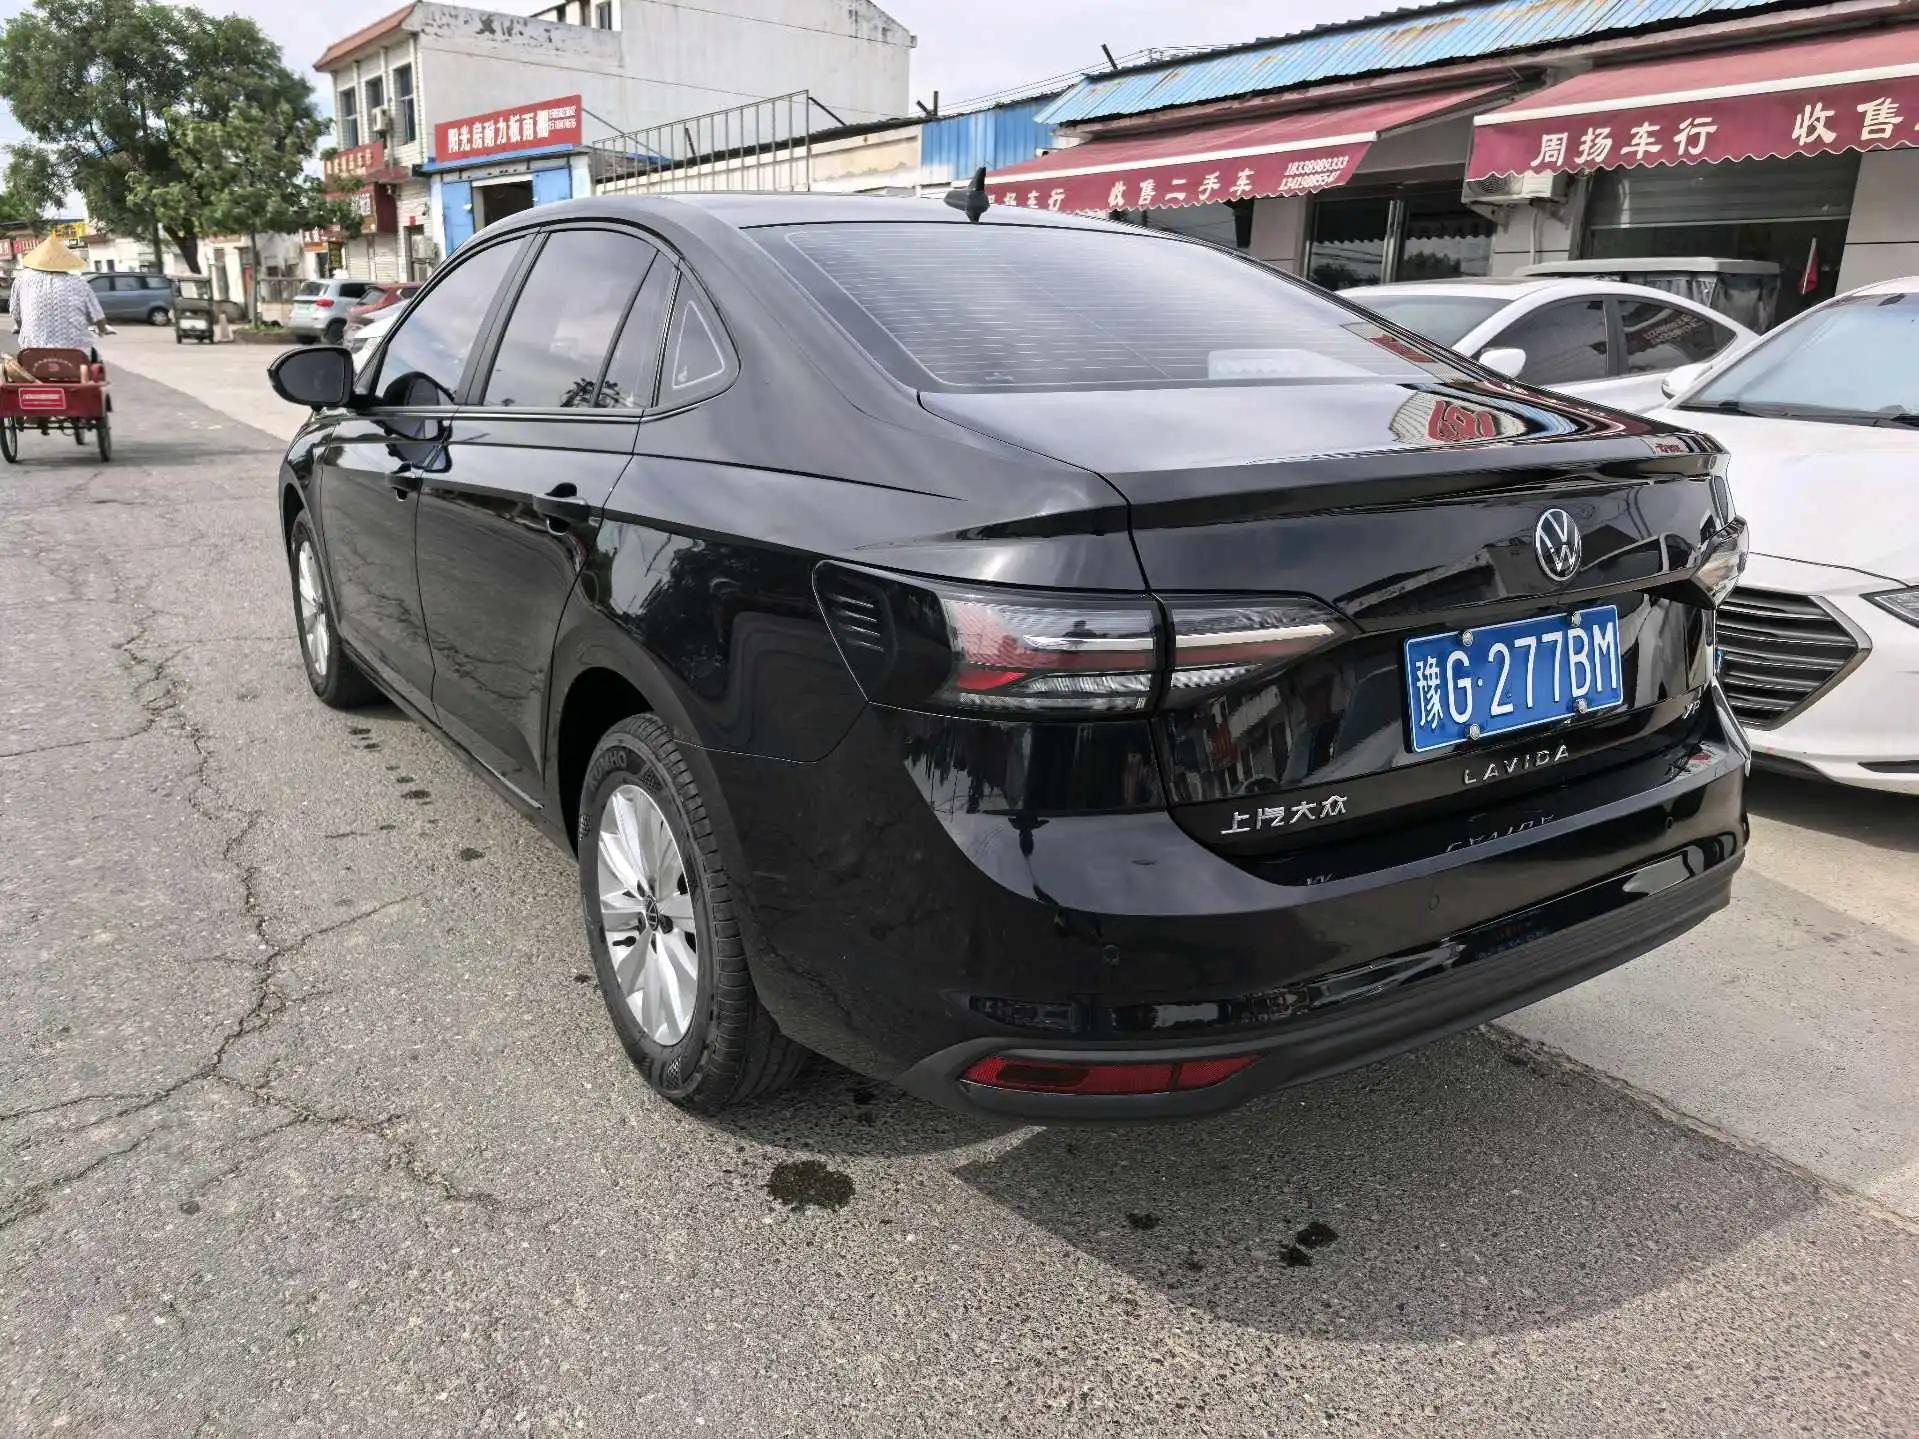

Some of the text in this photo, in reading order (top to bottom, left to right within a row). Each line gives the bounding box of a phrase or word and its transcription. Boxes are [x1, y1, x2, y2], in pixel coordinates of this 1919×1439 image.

[1530, 97, 1919, 167] 周扬车行 收售
[1108, 168, 1255, 208] 收售二手车
[1463, 744, 1570, 785] LAVIDA
[1220, 795, 1349, 836] 上汽大众
